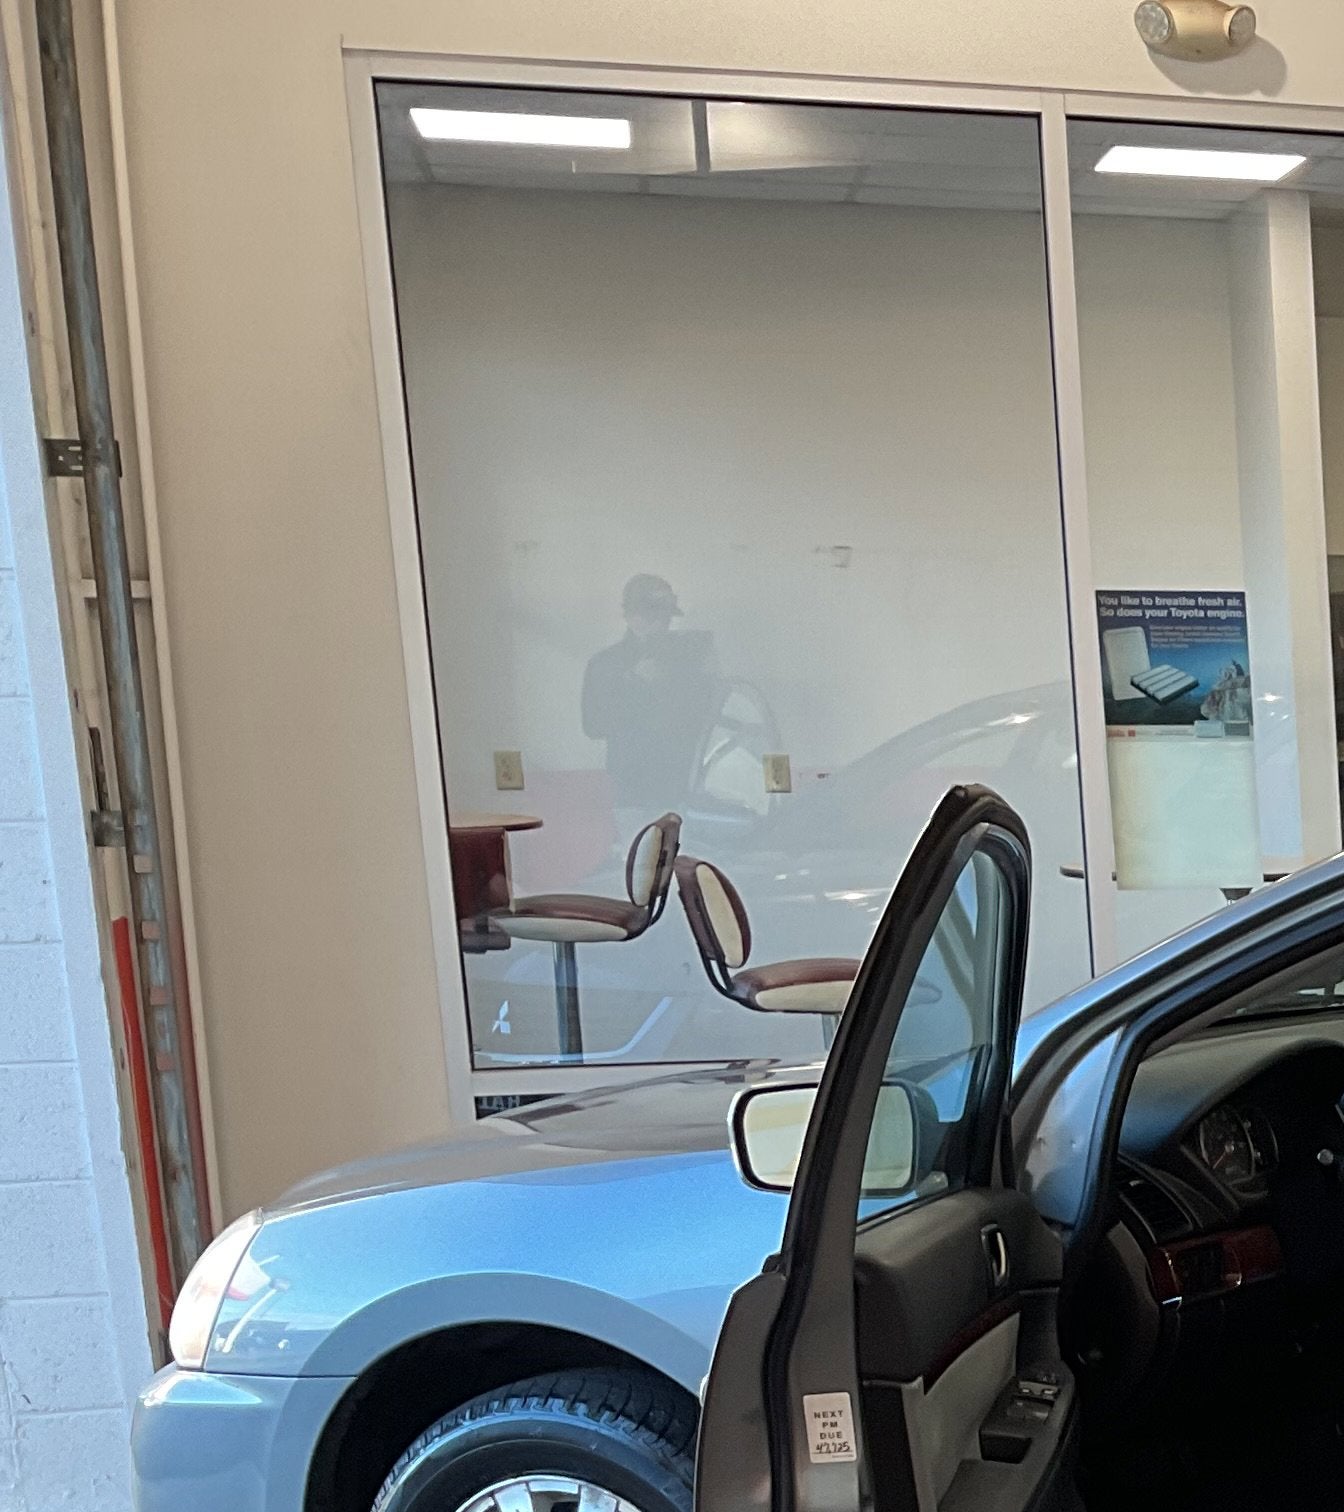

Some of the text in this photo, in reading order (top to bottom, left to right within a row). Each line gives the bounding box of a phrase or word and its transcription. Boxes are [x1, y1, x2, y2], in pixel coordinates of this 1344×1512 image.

[1099, 595, 1118, 605] You
[1121, 596, 1139, 605] like
[1142, 597, 1152, 605] to
[1100, 608, 1114, 616] So
[1145, 608, 1168, 619] your
[1170, 608, 1204, 619] Toyota
[814, 1410, 843, 1419] NEXT
